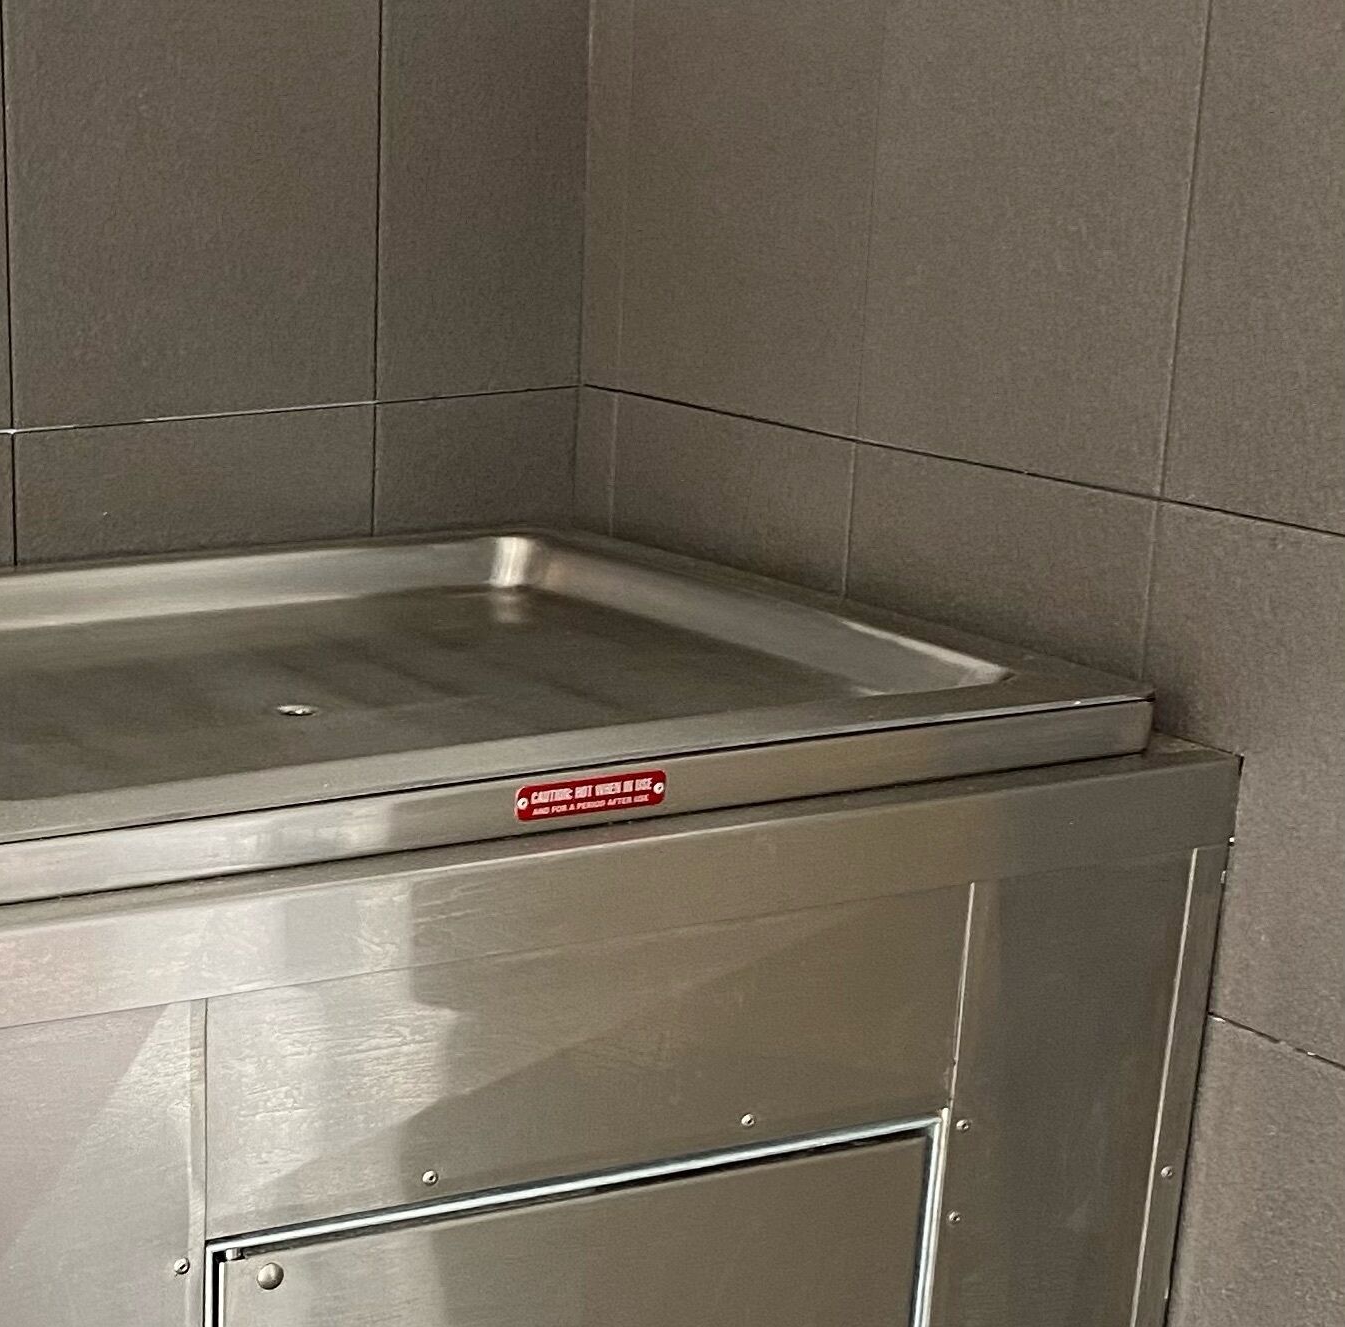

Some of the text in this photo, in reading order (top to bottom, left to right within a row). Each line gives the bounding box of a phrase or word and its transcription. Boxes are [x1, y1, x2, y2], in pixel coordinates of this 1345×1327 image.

[531, 788, 573, 804] CAUTION:
[574, 785, 593, 798] HOT
[595, 781, 622, 796] WHEN
[623, 780, 633, 792] IN
[532, 807, 549, 816] AND
[551, 805, 567, 813] FOR
[577, 800, 605, 810] PERIOD
[607, 796, 632, 806] AFTER
